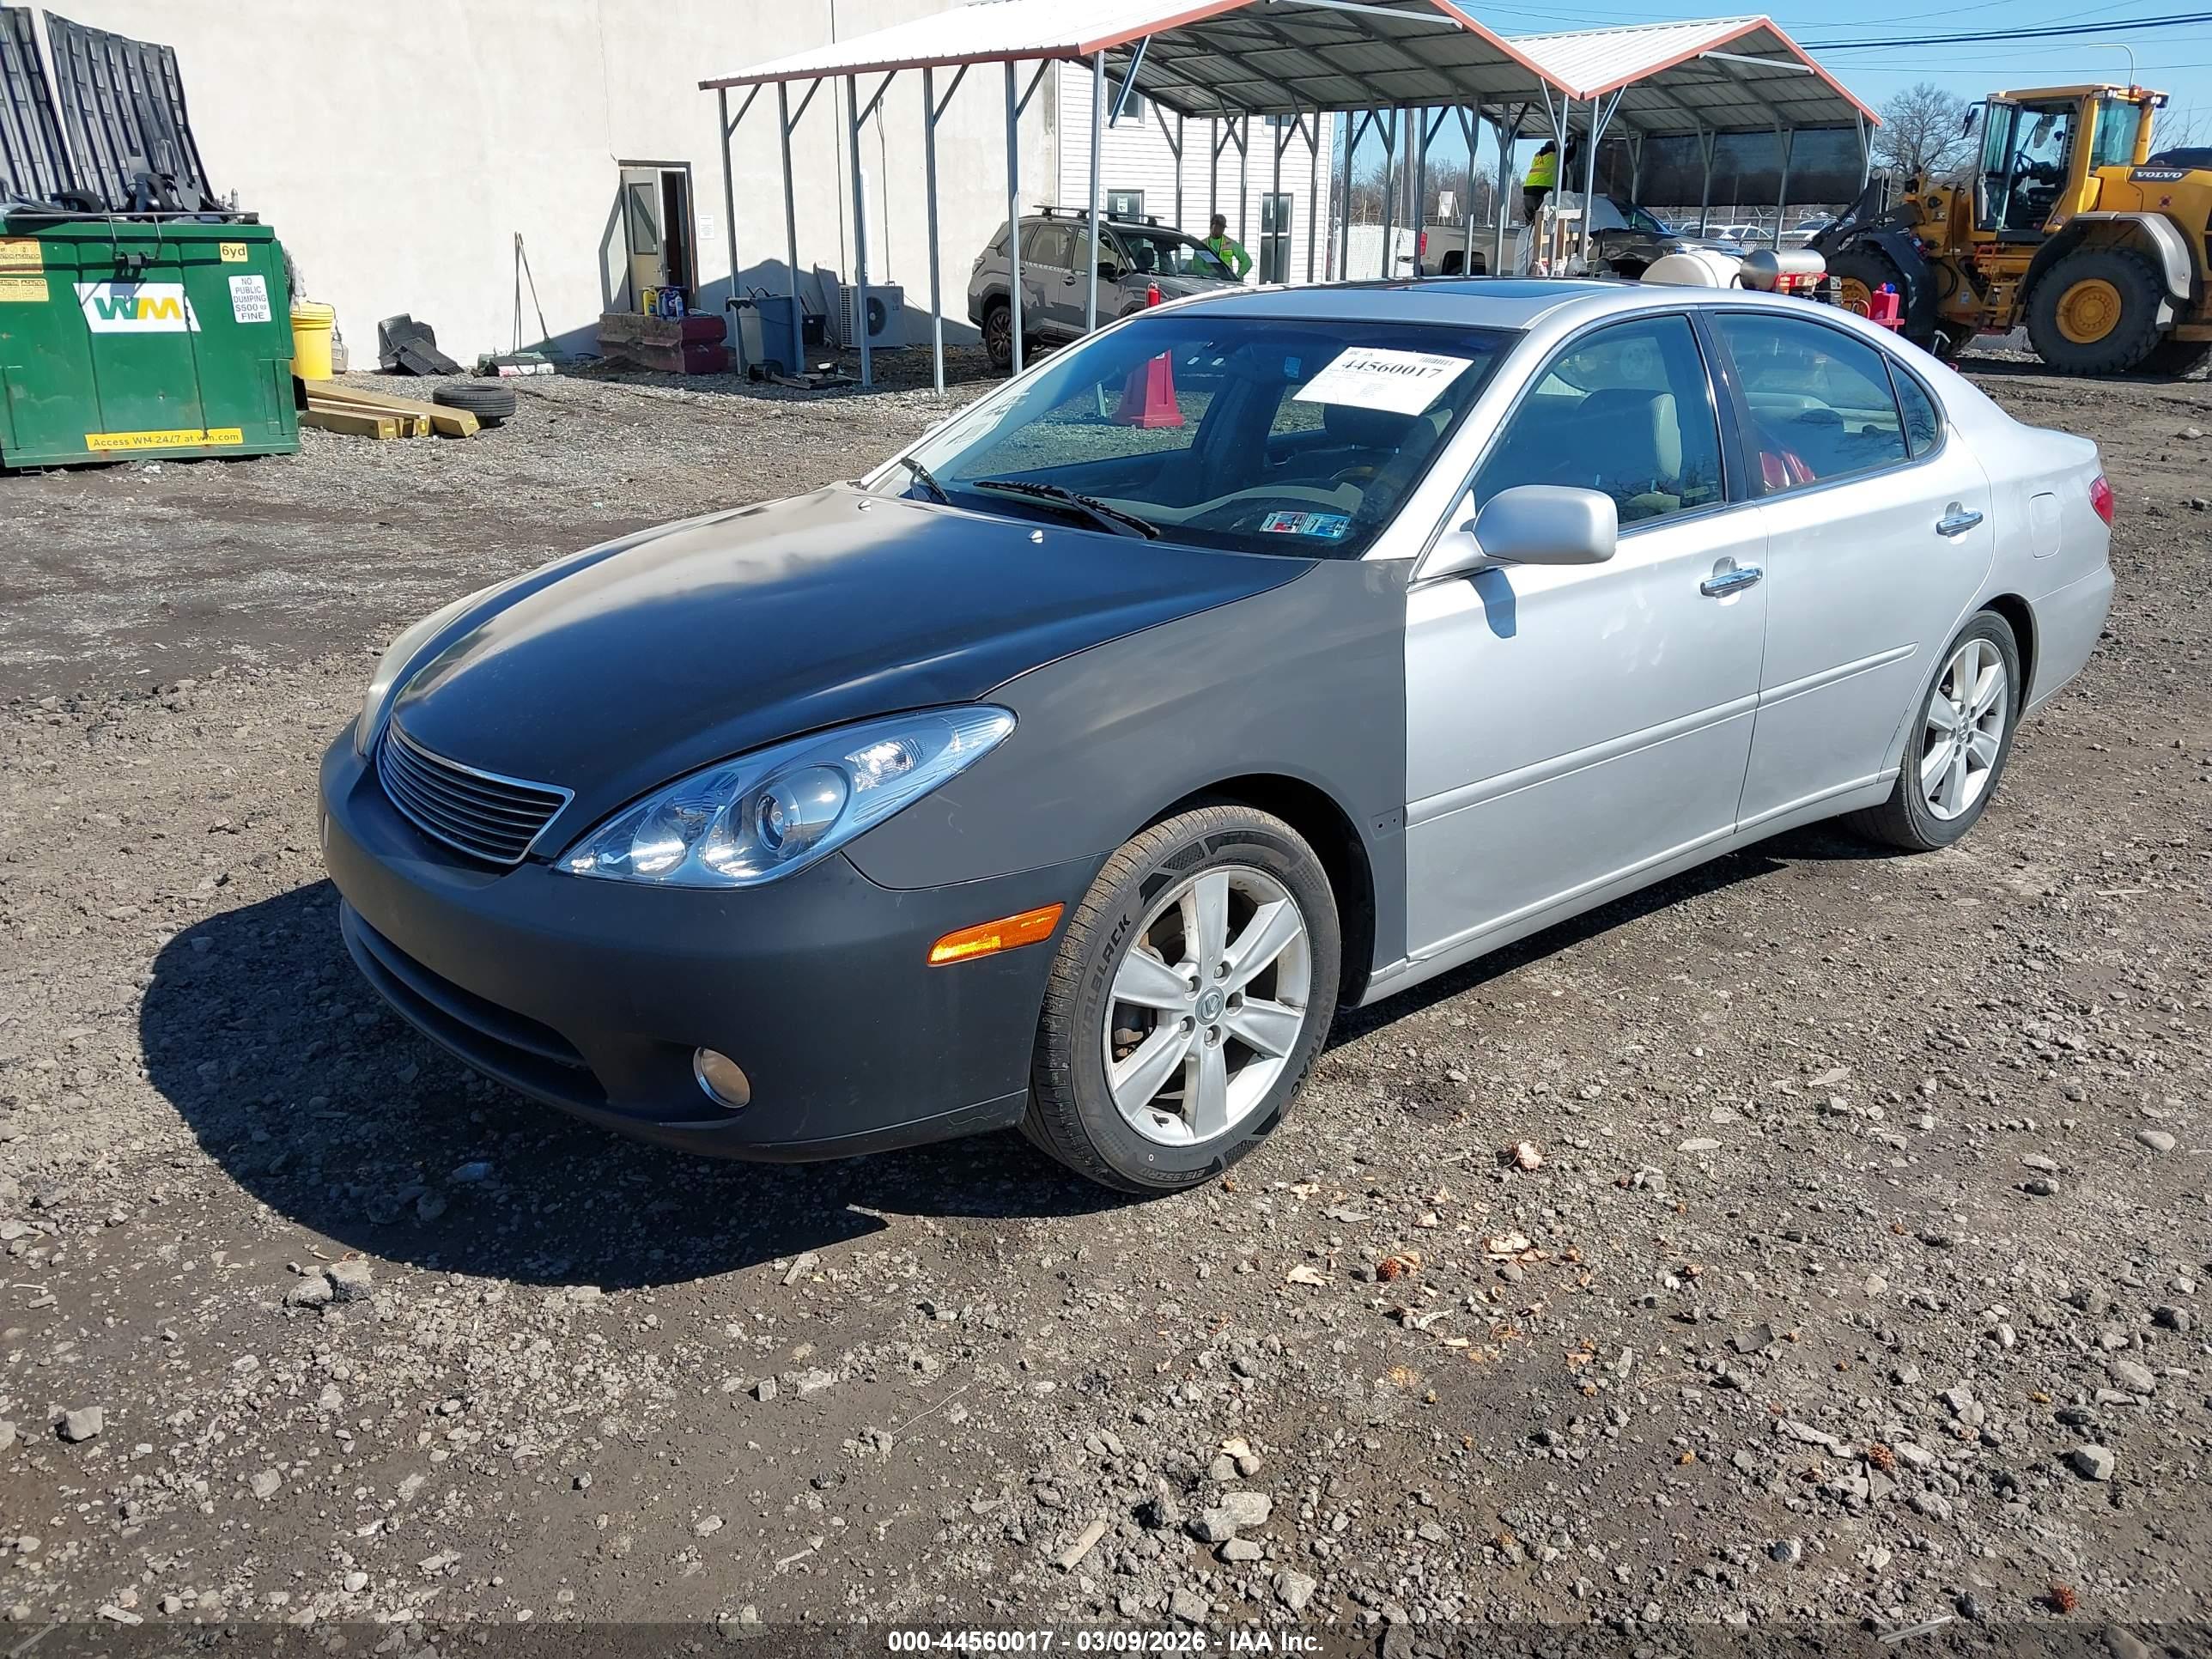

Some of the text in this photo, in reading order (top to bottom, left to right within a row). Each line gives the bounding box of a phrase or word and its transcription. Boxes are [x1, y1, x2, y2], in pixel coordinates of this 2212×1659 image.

[222, 246, 246, 258] 6yd
[235, 286, 262, 295] PUBLIC
[233, 294, 267, 303] DUMPING
[94, 297, 183, 319] WM
[241, 312, 265, 320] FINE
[1341, 359, 1444, 379] 44560017
[93, 436, 130, 447] Access
[132, 436, 153, 445] WM
[155, 434, 180, 444] 24/7
[185, 434, 194, 443] at
